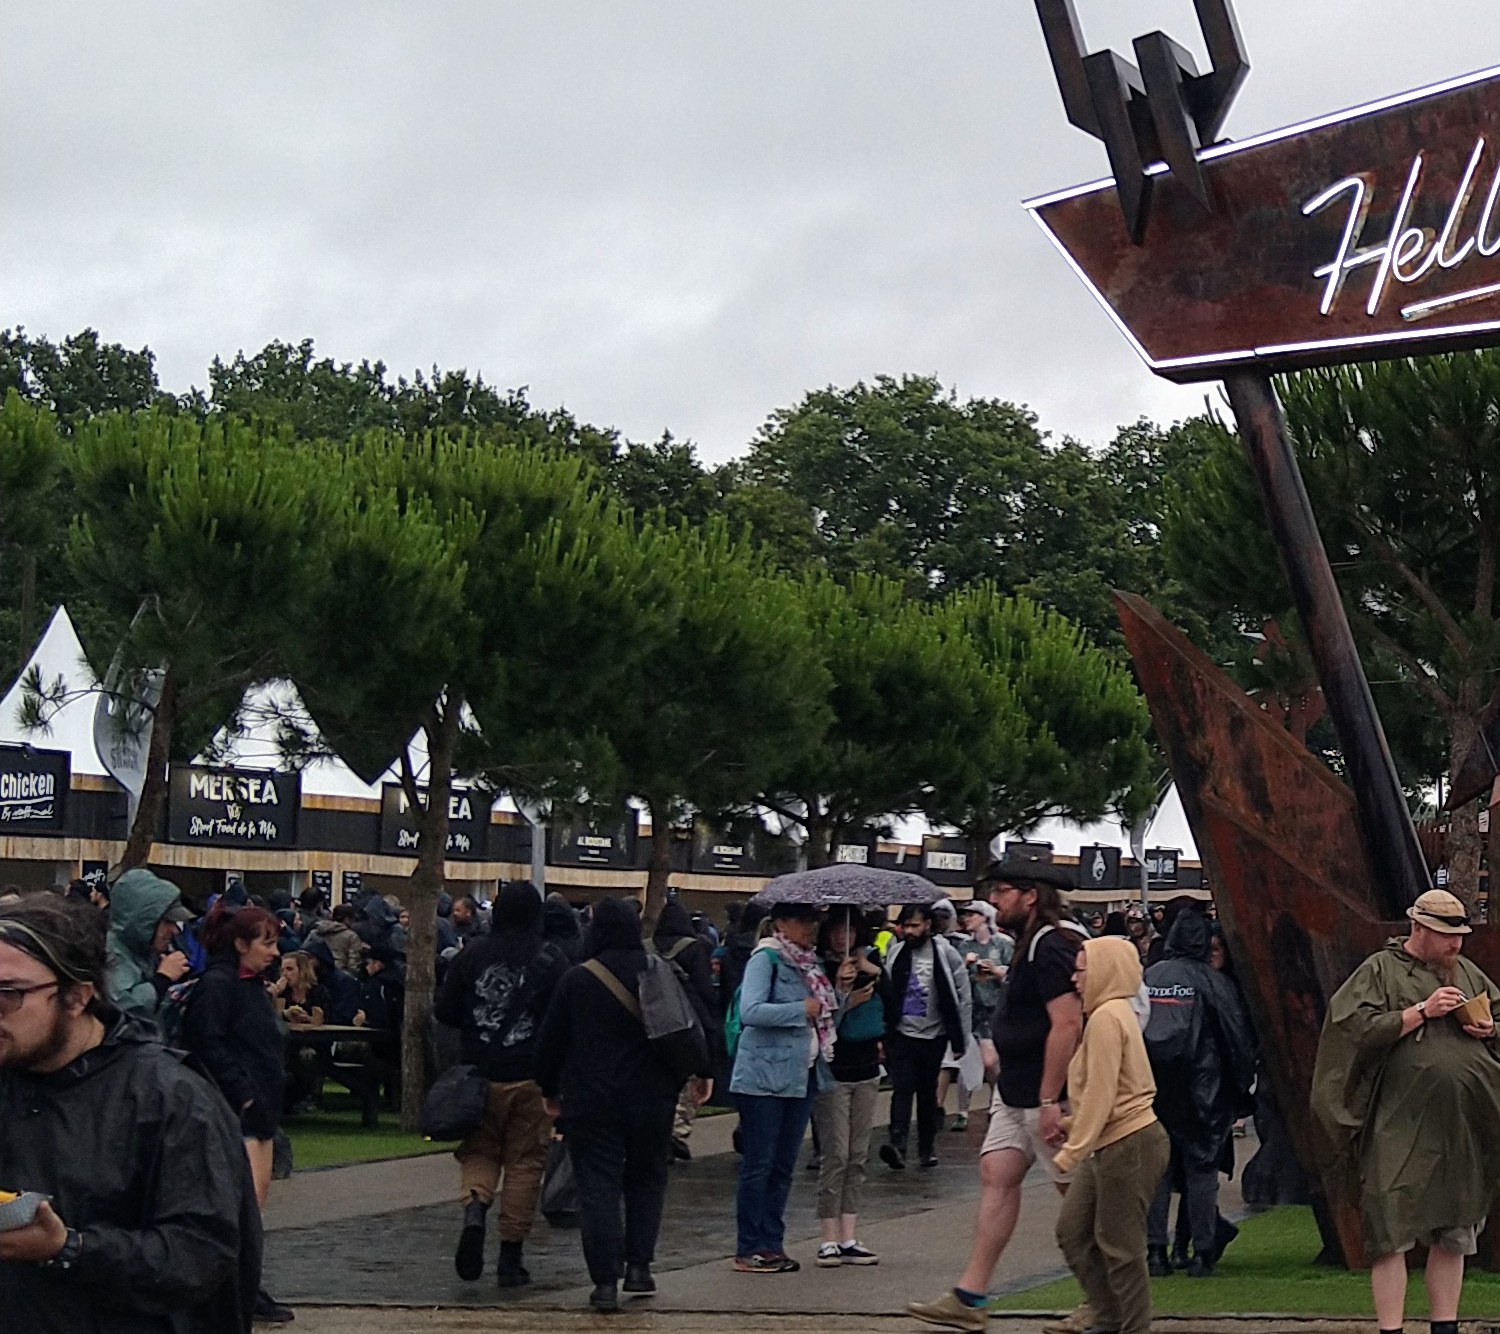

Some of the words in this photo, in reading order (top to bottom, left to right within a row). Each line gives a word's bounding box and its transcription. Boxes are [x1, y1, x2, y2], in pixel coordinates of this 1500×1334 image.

[1, 772, 55, 799] Chicken
[190, 773, 279, 805] MERSEA
[216, 819, 237, 836] Food
